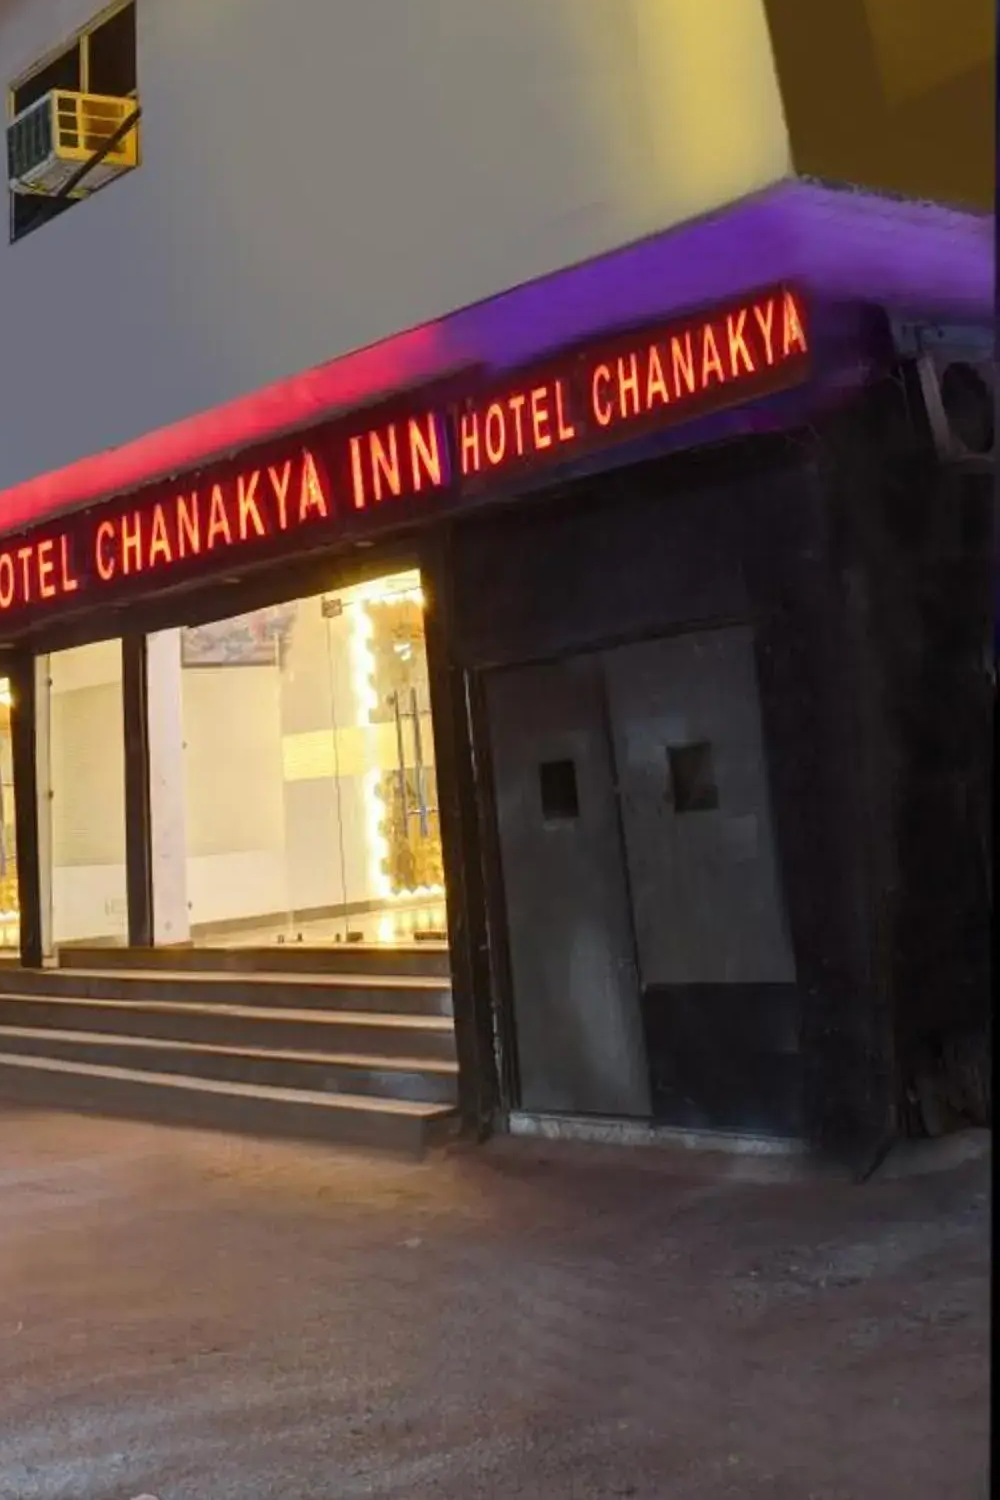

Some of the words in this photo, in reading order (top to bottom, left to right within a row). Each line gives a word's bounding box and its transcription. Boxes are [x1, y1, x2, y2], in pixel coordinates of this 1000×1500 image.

[459, 379, 575, 475] HOTEL
[591, 291, 807, 427] CHANAKYA
[96, 449, 328, 580] CHANAKYA
[348, 410, 443, 510] INN
